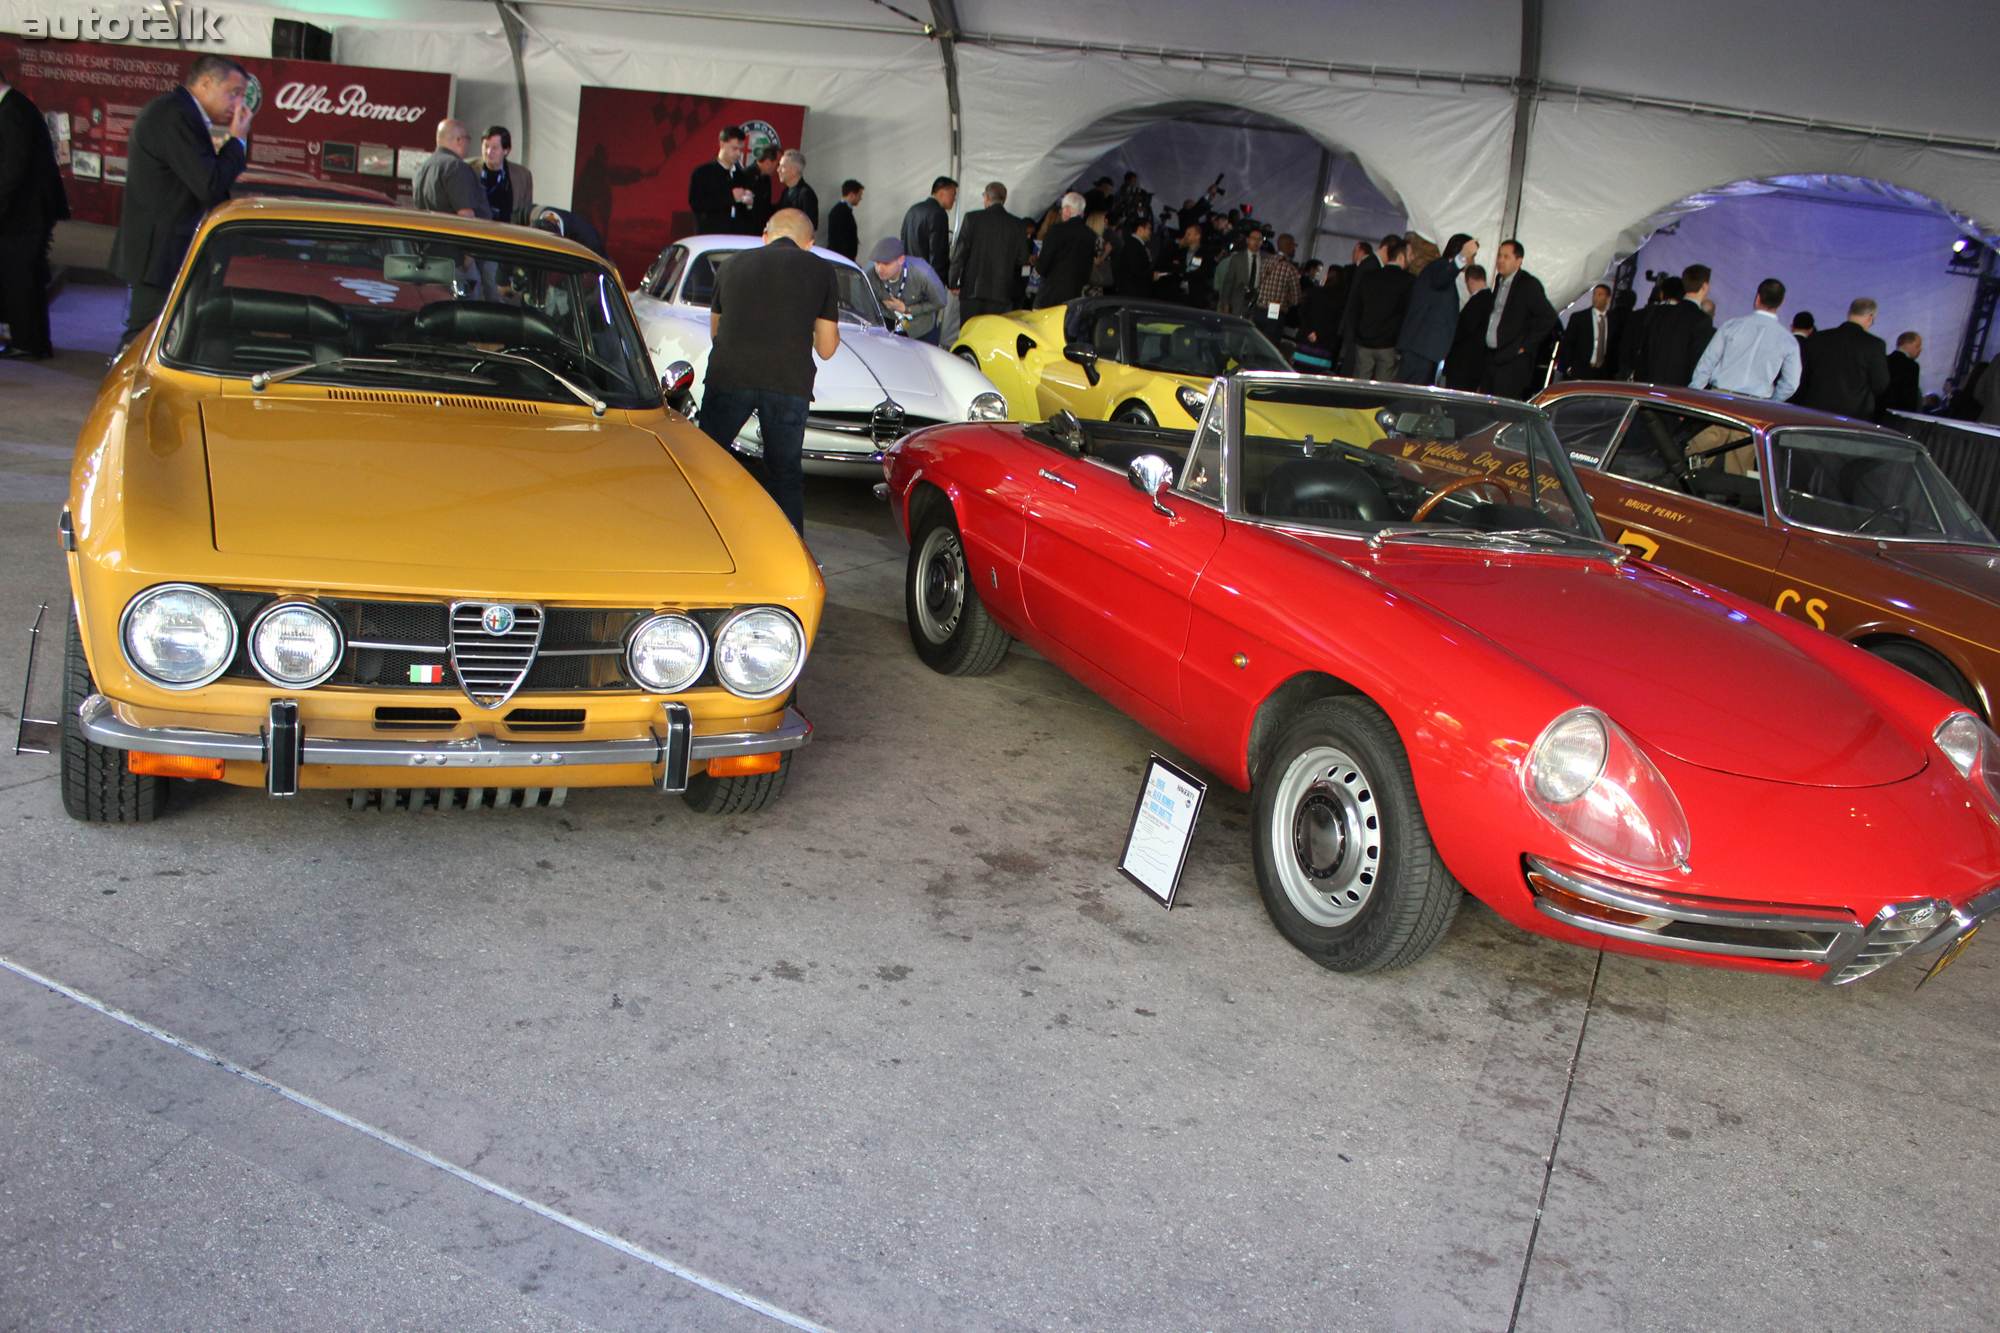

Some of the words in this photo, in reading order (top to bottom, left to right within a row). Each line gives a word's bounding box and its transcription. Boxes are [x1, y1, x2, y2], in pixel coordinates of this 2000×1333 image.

[75, 54, 89, 67] THE
[90, 56, 111, 70] SAME
[112, 57, 162, 75] TENDERNESS
[163, 63, 180, 77] ONE
[275, 82, 335, 123] Alfa
[334, 84, 426, 123] Romeo
[1420, 441, 1468, 461] Yellow
[1473, 451, 1503, 475] Dog
[1506, 461, 1561, 494] Gaage
[1570, 451, 1599, 464] CARRILLO
[1625, 498, 1652, 513] BRUCE
[1653, 505, 1686, 523] PERRY
